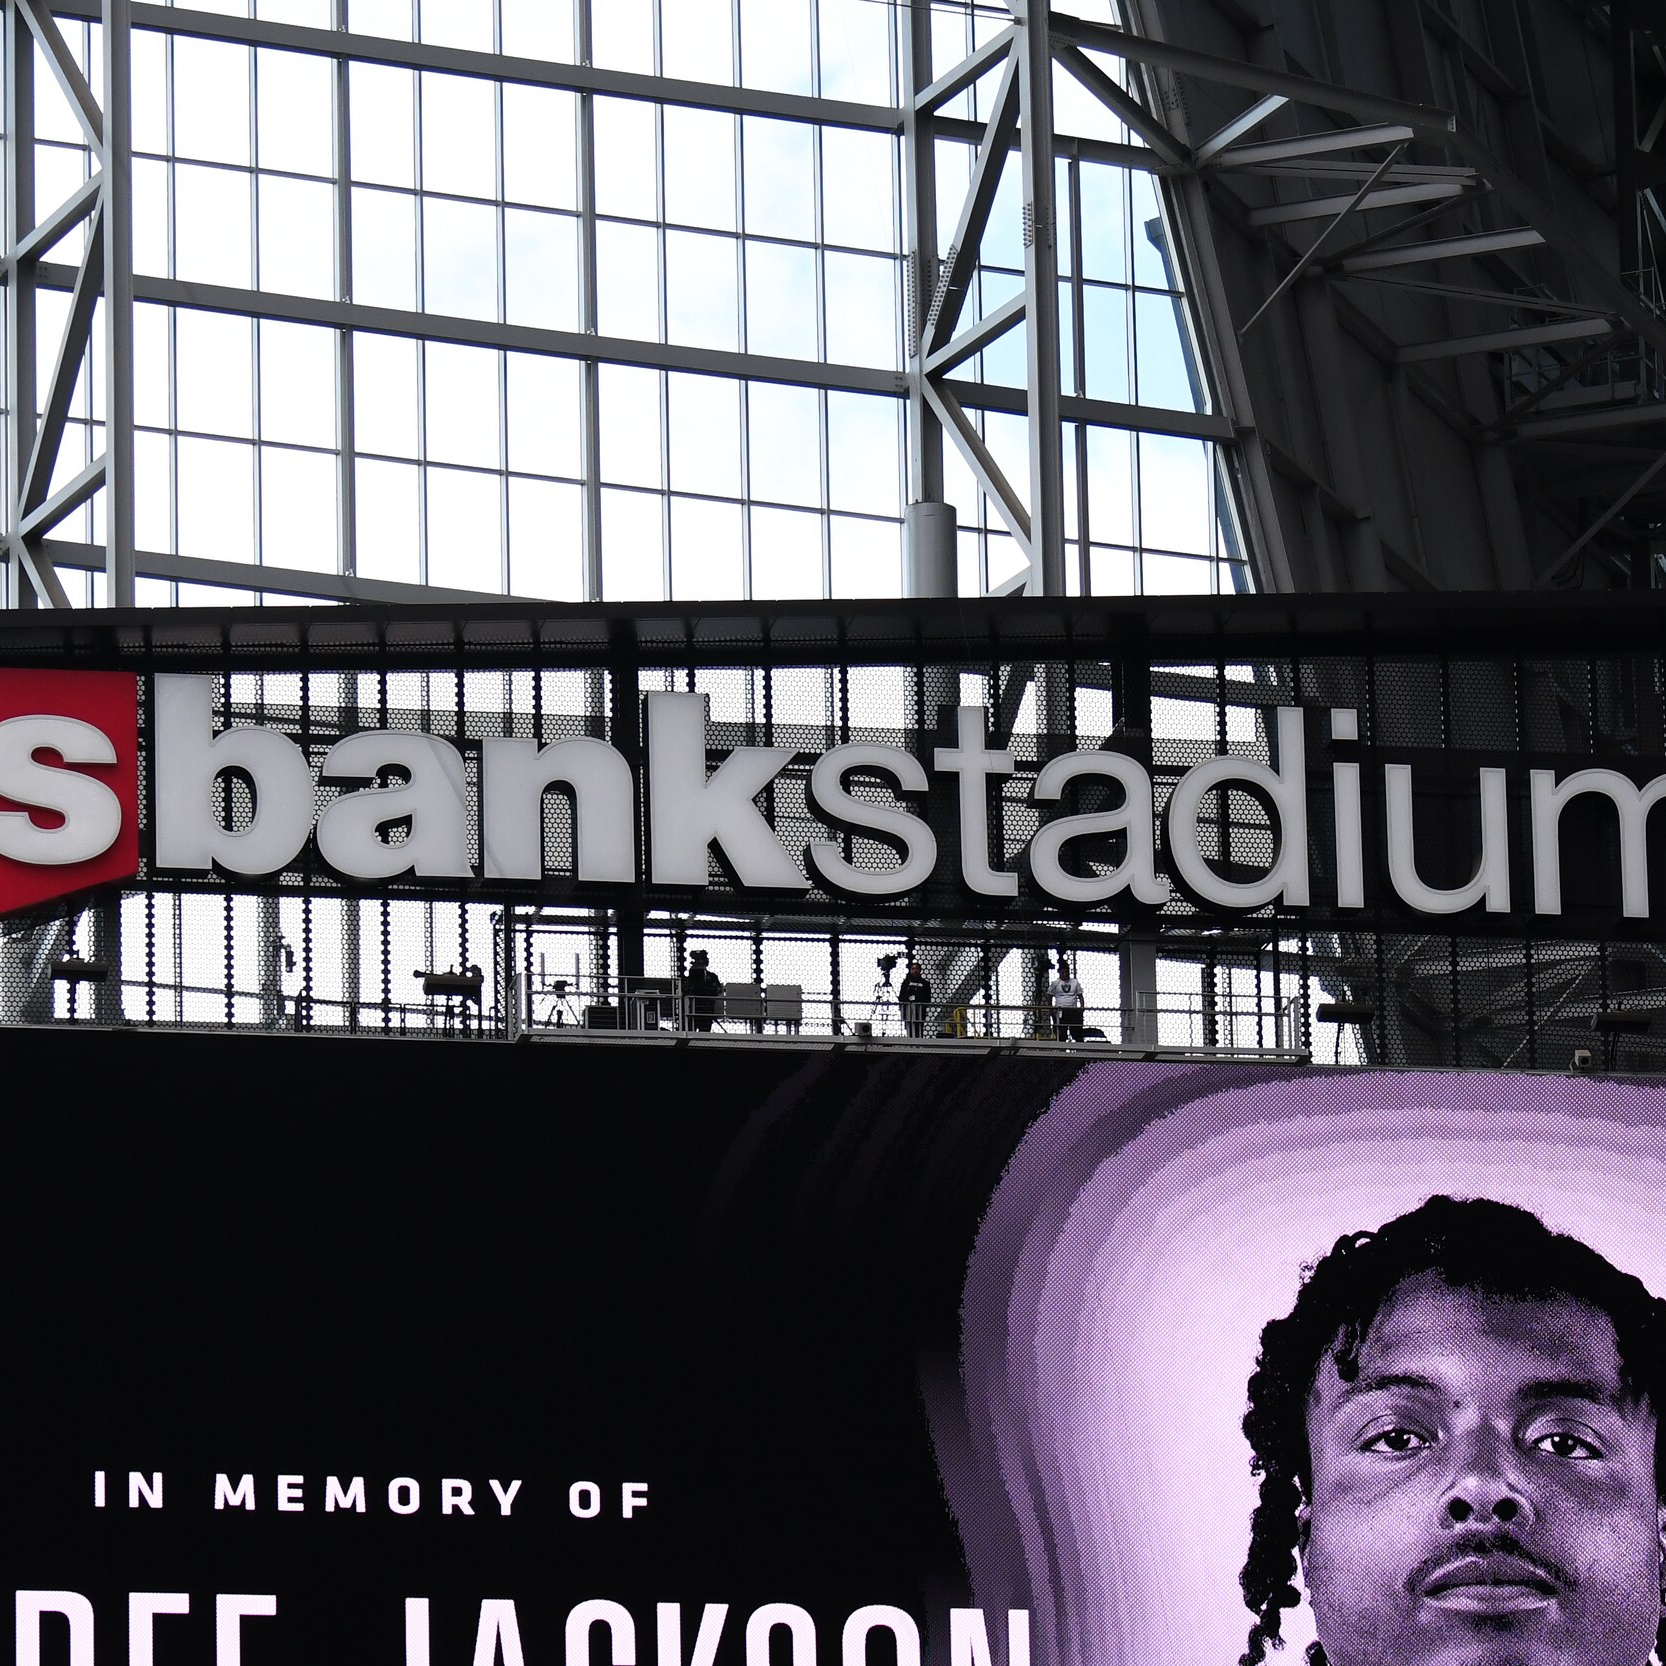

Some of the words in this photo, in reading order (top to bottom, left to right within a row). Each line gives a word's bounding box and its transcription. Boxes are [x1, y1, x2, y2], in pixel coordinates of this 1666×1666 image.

[94, 1469, 165, 1510] IN
[214, 1473, 524, 1517] MEMORY
[567, 1480, 651, 1520] OF
